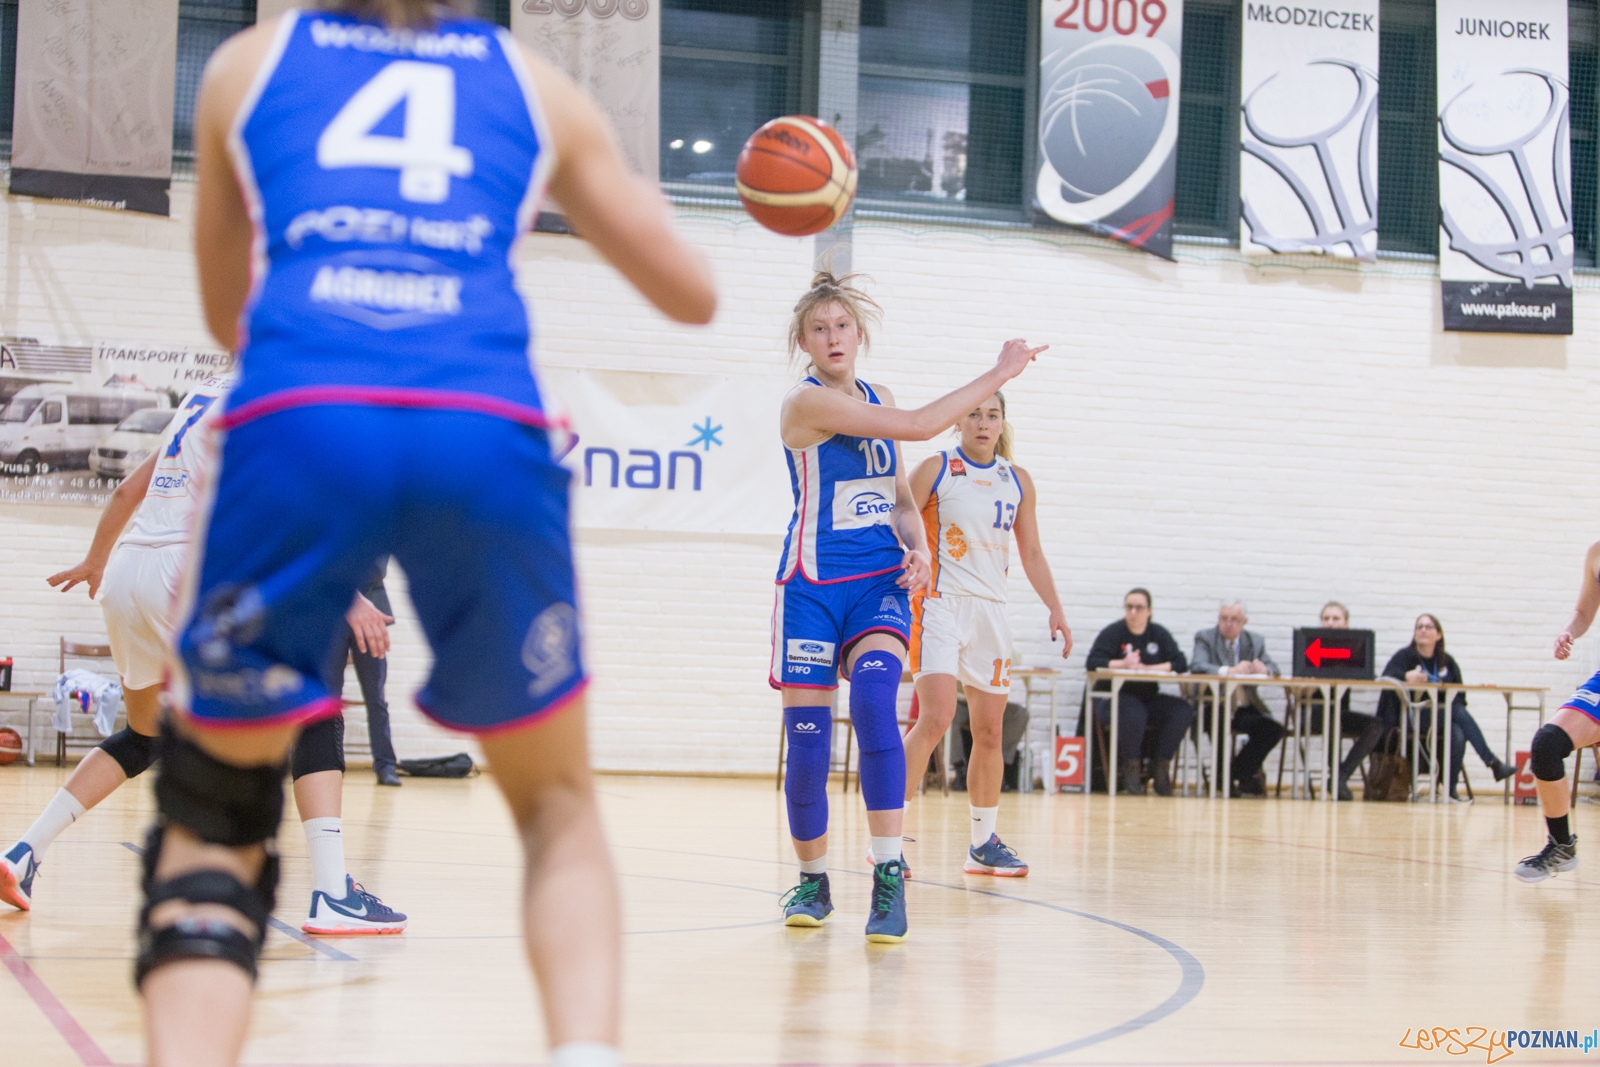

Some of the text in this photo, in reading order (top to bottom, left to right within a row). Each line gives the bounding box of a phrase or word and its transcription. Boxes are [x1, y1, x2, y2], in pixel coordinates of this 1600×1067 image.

[1054, 0, 1167, 38] 2009
[1247, 3, 1374, 32] MŁODZICZEK
[1455, 17, 1550, 40] JUNIOREK
[317, 60, 474, 204] 4
[1461, 301, 1556, 321] www.pzkosz.pl
[98, 347, 187, 363] TRANSPORT
[164, 394, 219, 459] 7
[36, 462, 49, 474] 19
[858, 438, 891, 476] 10
[70, 477, 84, 488] 48
[89, 477, 101, 488] 61
[993, 500, 1015, 532] 13
[810, 656, 832, 665] Motors
[990, 657, 1011, 688] 13
[1055, 743, 1081, 778] 5
